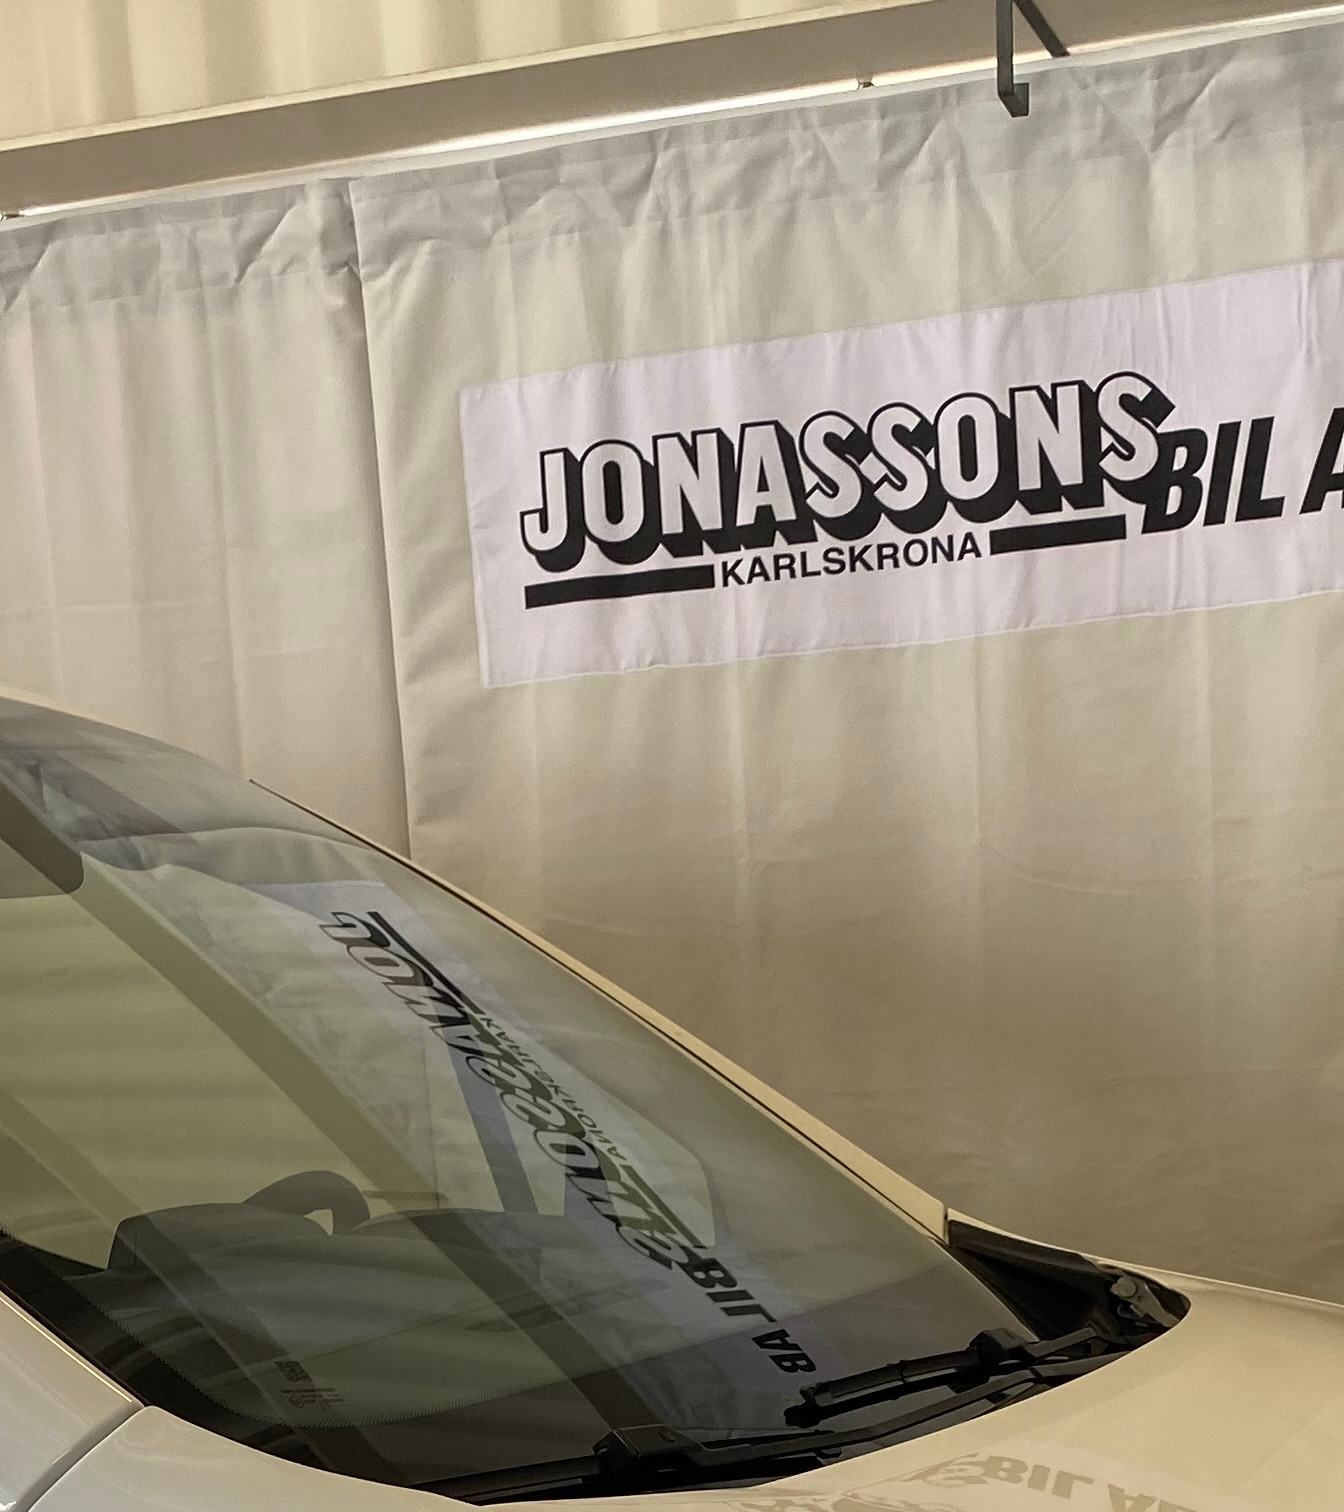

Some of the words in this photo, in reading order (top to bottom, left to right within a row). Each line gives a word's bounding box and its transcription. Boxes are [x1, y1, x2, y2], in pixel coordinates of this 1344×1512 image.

[520, 371, 1175, 572] JONASSONS
[1140, 415, 1282, 534] BIL
[720, 530, 984, 588] KARLSKRONA
